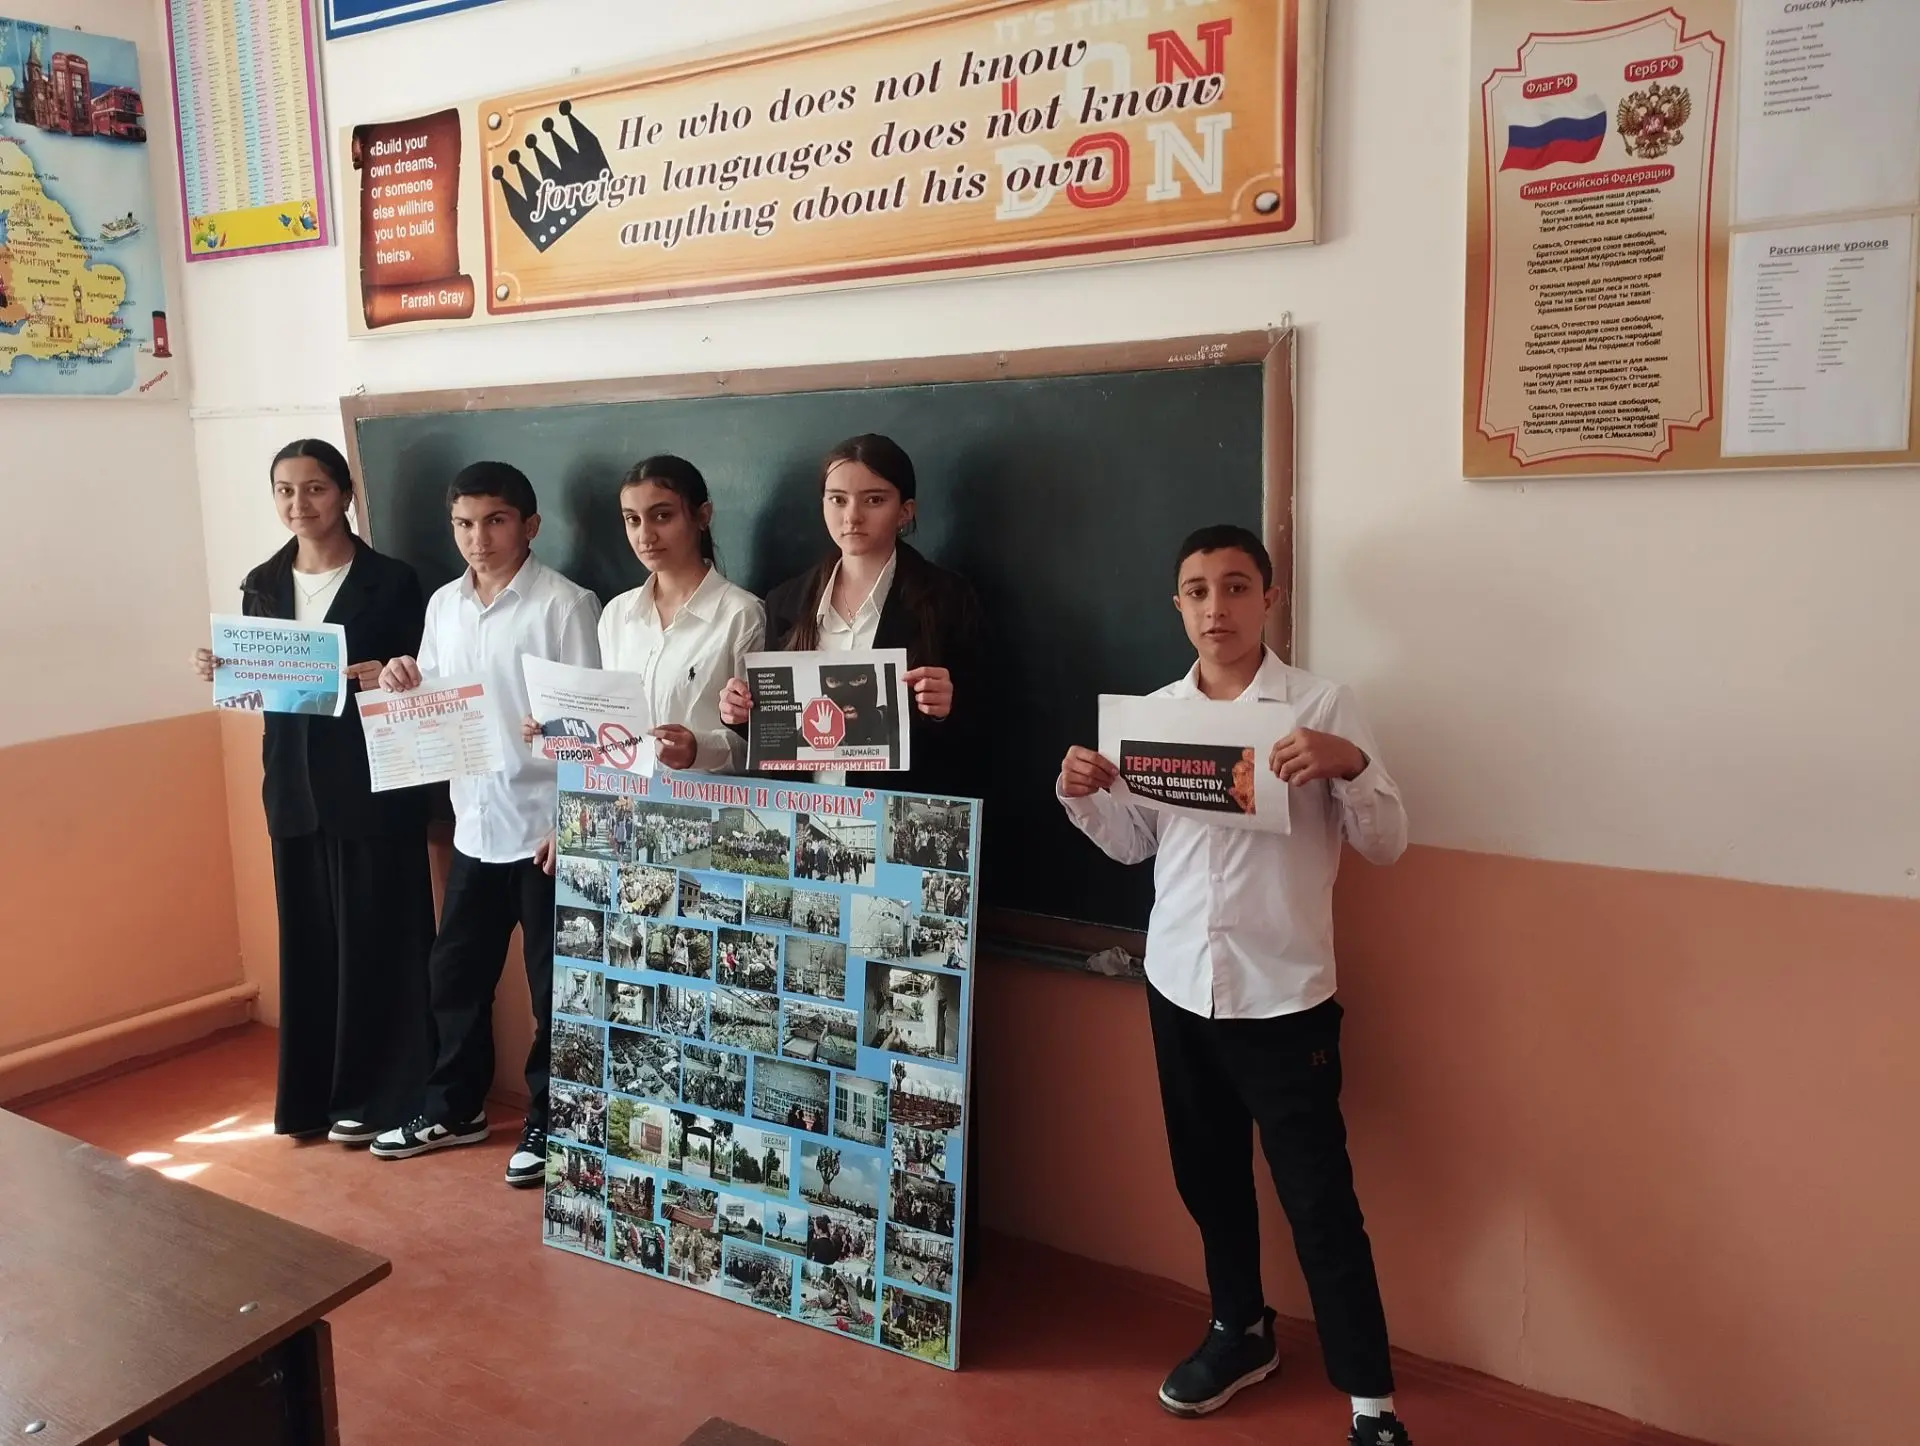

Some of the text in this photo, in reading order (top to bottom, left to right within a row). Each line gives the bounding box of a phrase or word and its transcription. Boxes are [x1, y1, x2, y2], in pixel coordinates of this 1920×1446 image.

[993, 0, 1148, 43] IT'S TIME
[1000, 17, 1232, 126] ON
[1629, 58, 1678, 77] Герб РФ
[1526, 76, 1573, 94] Флаг РФ
[616, 39, 1087, 151] He who does not know
[370, 135, 428, 156] «Build your
[530, 76, 1222, 223] foreign languages does not know
[370, 156, 437, 178] own dreams,
[994, 113, 1232, 220] DON
[371, 179, 433, 199] or someone
[1523, 167, 1671, 196] Гимн Российской Федерации
[373, 199, 434, 220] else willhire
[620, 154, 1105, 248] anything about his own
[374, 219, 435, 244] you to build
[376, 248, 415, 265] theirs».
[1769, 239, 1889, 256] Расписание уроков
[19, 256, 55, 267] АНГЛИЯ
[401, 290, 464, 309] Farrah Gray
[86, 314, 124, 325] Лондон
[318, 635, 325, 643] и
[232, 642, 311, 656] ТЕРРОРИЗМ
[278, 660, 337, 670] опасность
[234, 671, 323, 683] современности
[383, 701, 469, 724] ТЕРРОРИЗМ
[562, 719, 590, 737] МЫ
[545, 736, 581, 750] ПРОТИВ
[813, 736, 835, 745] СТОП
[555, 748, 593, 761] ТЕРРОРА
[841, 747, 880, 757] ЗАДУМАЙСЯ
[761, 761, 884, 770] СКАЖИ ЭКСТРЕМИЗМУ НЕТ!
[1125, 756, 1216, 776] ТЕРРОРИЗМ
[1125, 774, 1227, 791] УГРОЗА ОБЩЕСТВУ.
[756, 790, 769, 809] И
[1165, 790, 1229, 804] БДИТЕЛЬНЫ.
[763, 1136, 786, 1146] БЕСЛАН
